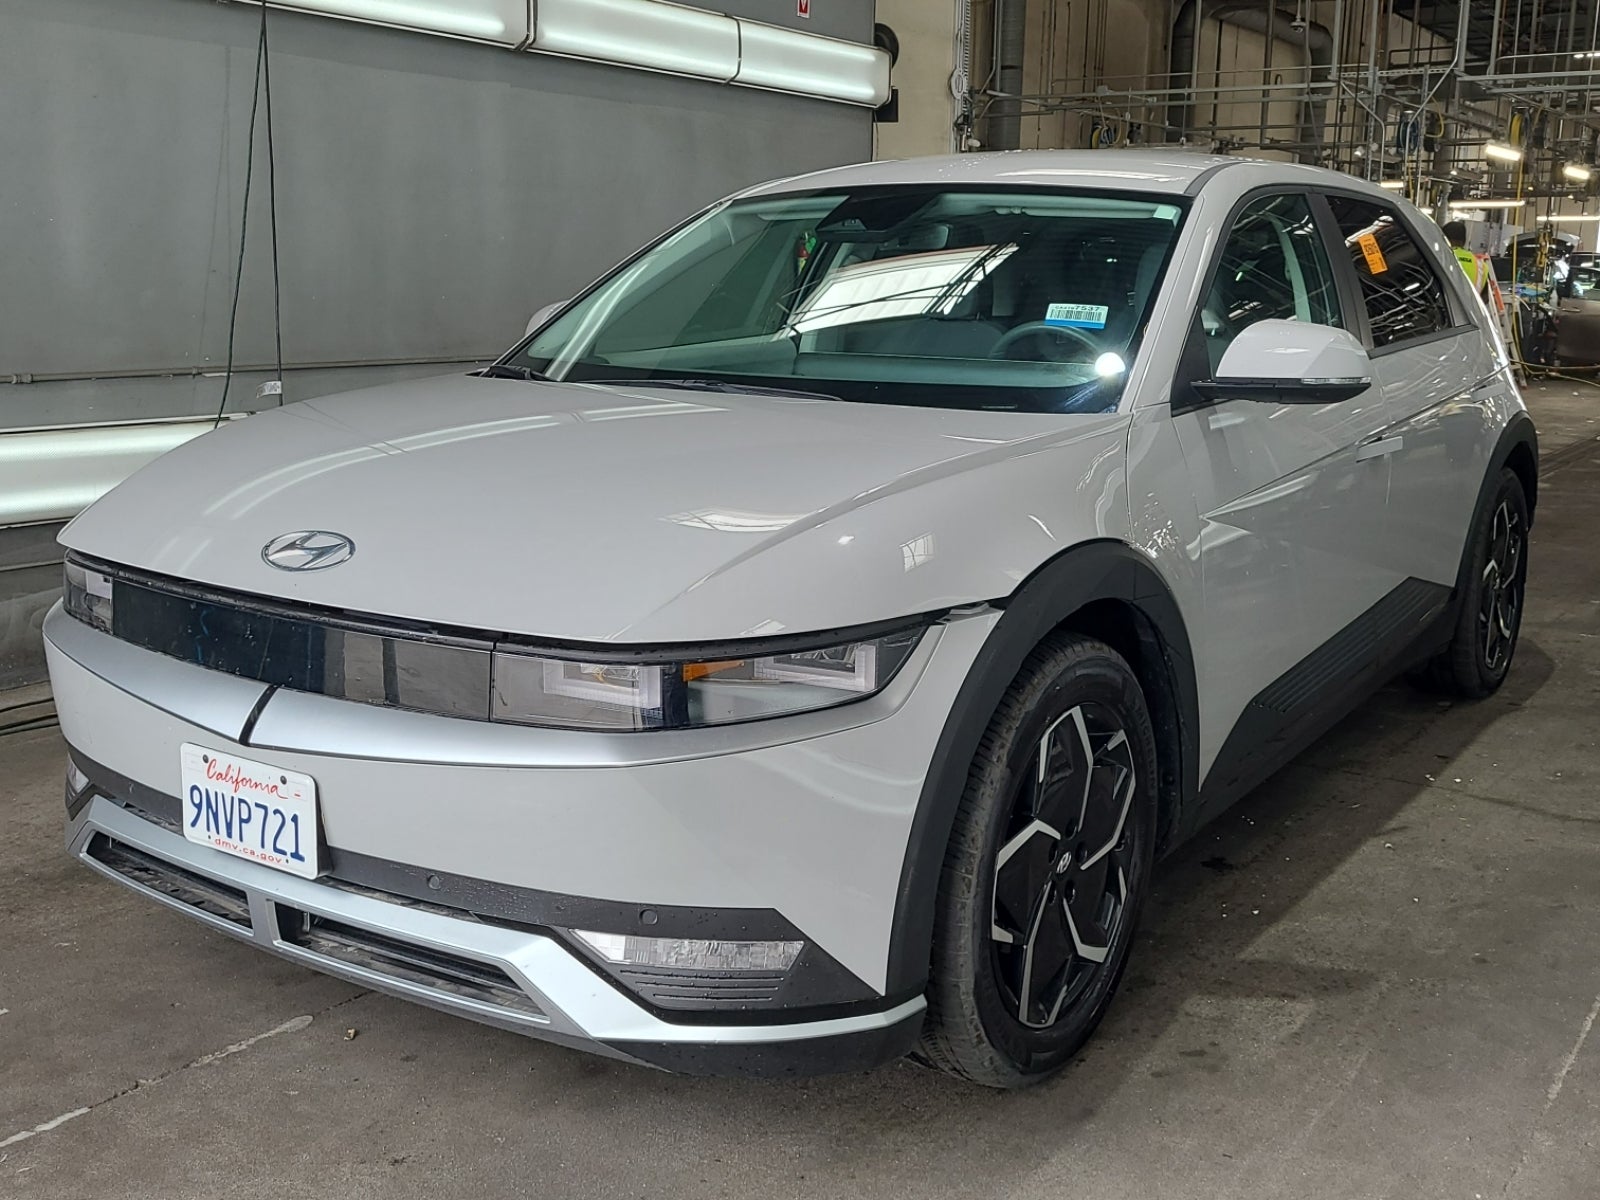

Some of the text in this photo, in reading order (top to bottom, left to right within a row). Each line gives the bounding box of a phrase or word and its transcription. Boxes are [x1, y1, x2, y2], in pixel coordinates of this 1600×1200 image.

[206, 758, 288, 799] California
[189, 784, 305, 862] 9NVP721
[214, 837, 282, 863] dmv.ca.gov
